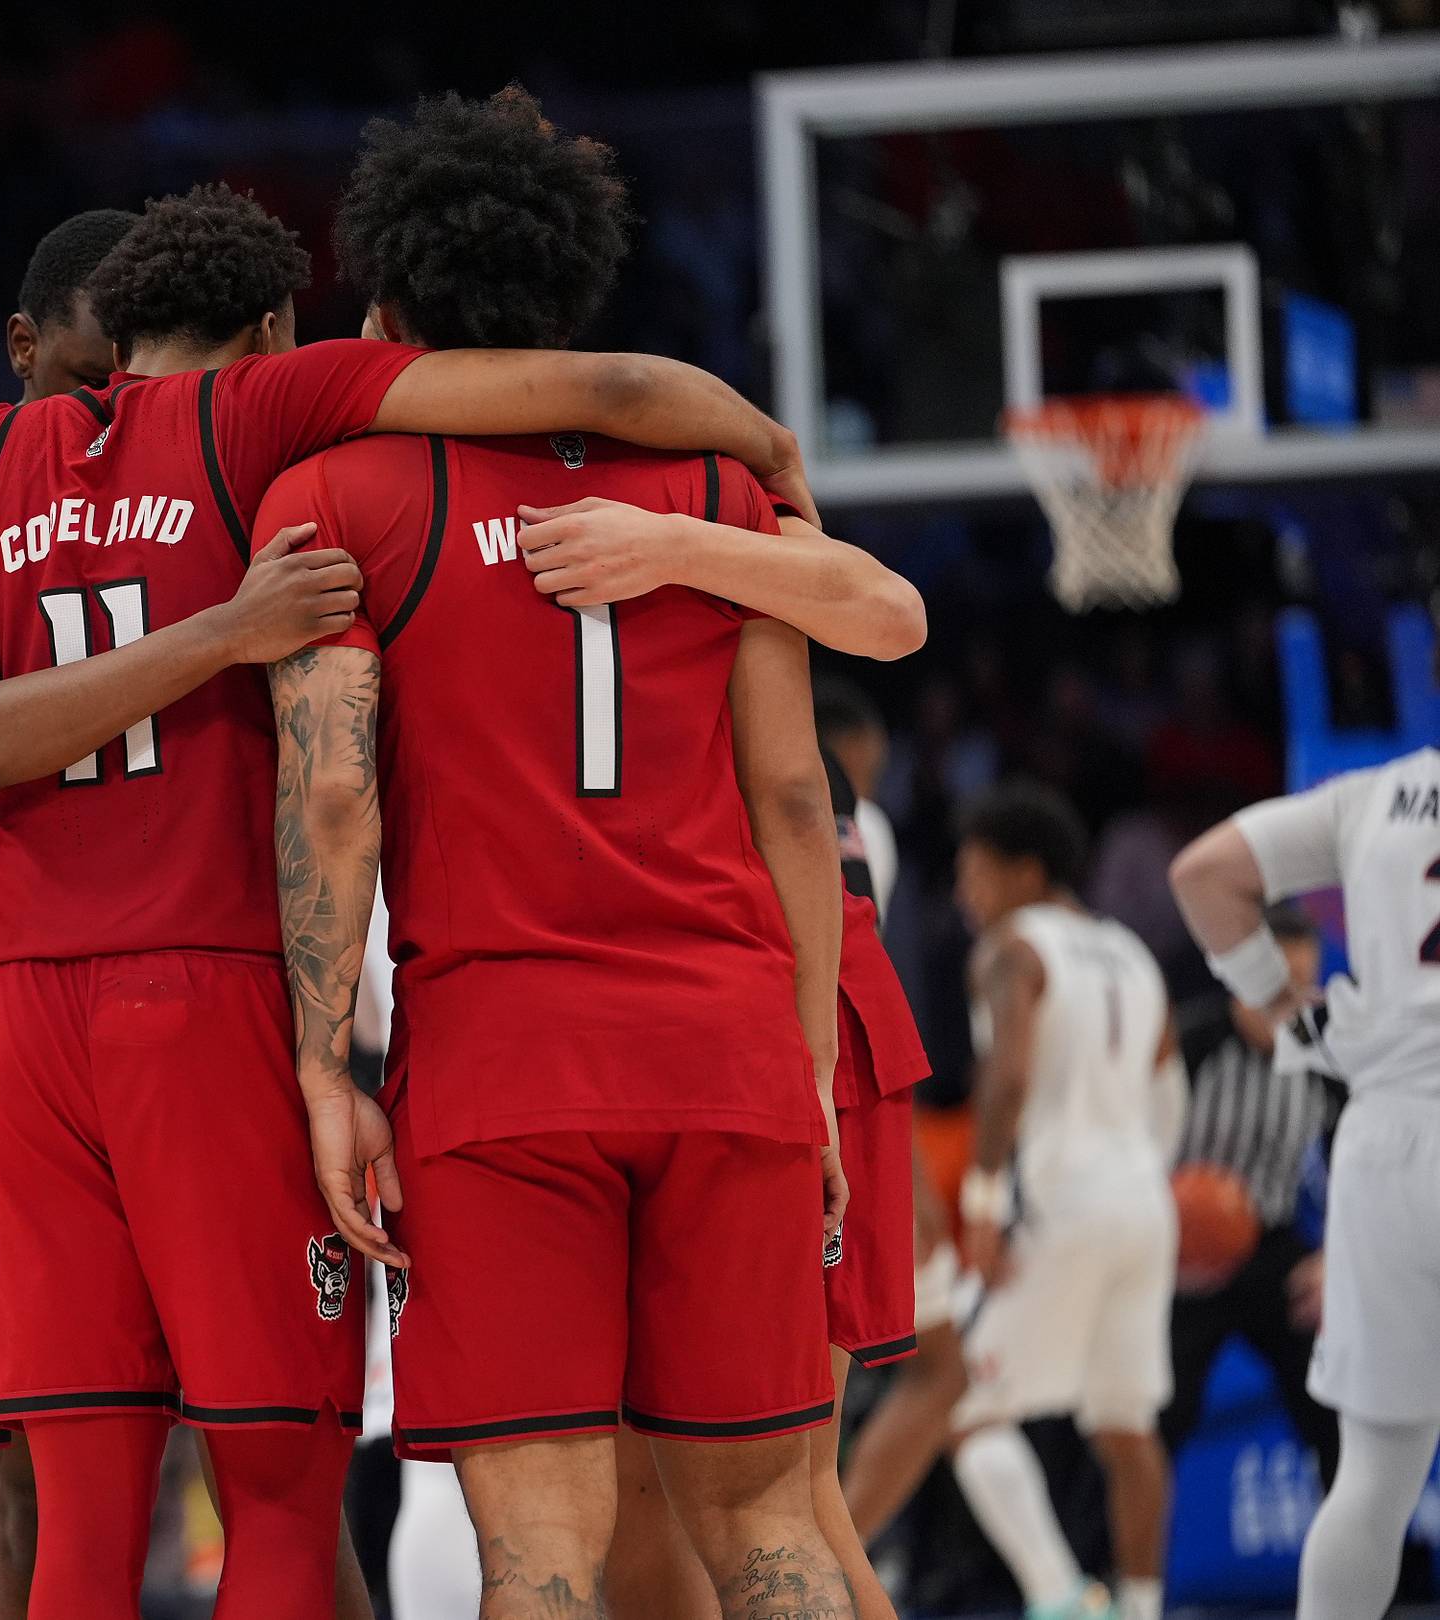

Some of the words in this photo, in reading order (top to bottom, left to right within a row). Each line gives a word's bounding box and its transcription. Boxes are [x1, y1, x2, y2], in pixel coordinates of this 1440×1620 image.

[38, 576, 163, 788] 11
[572, 602, 623, 798] 1
[743, 1546, 785, 1571] Just
